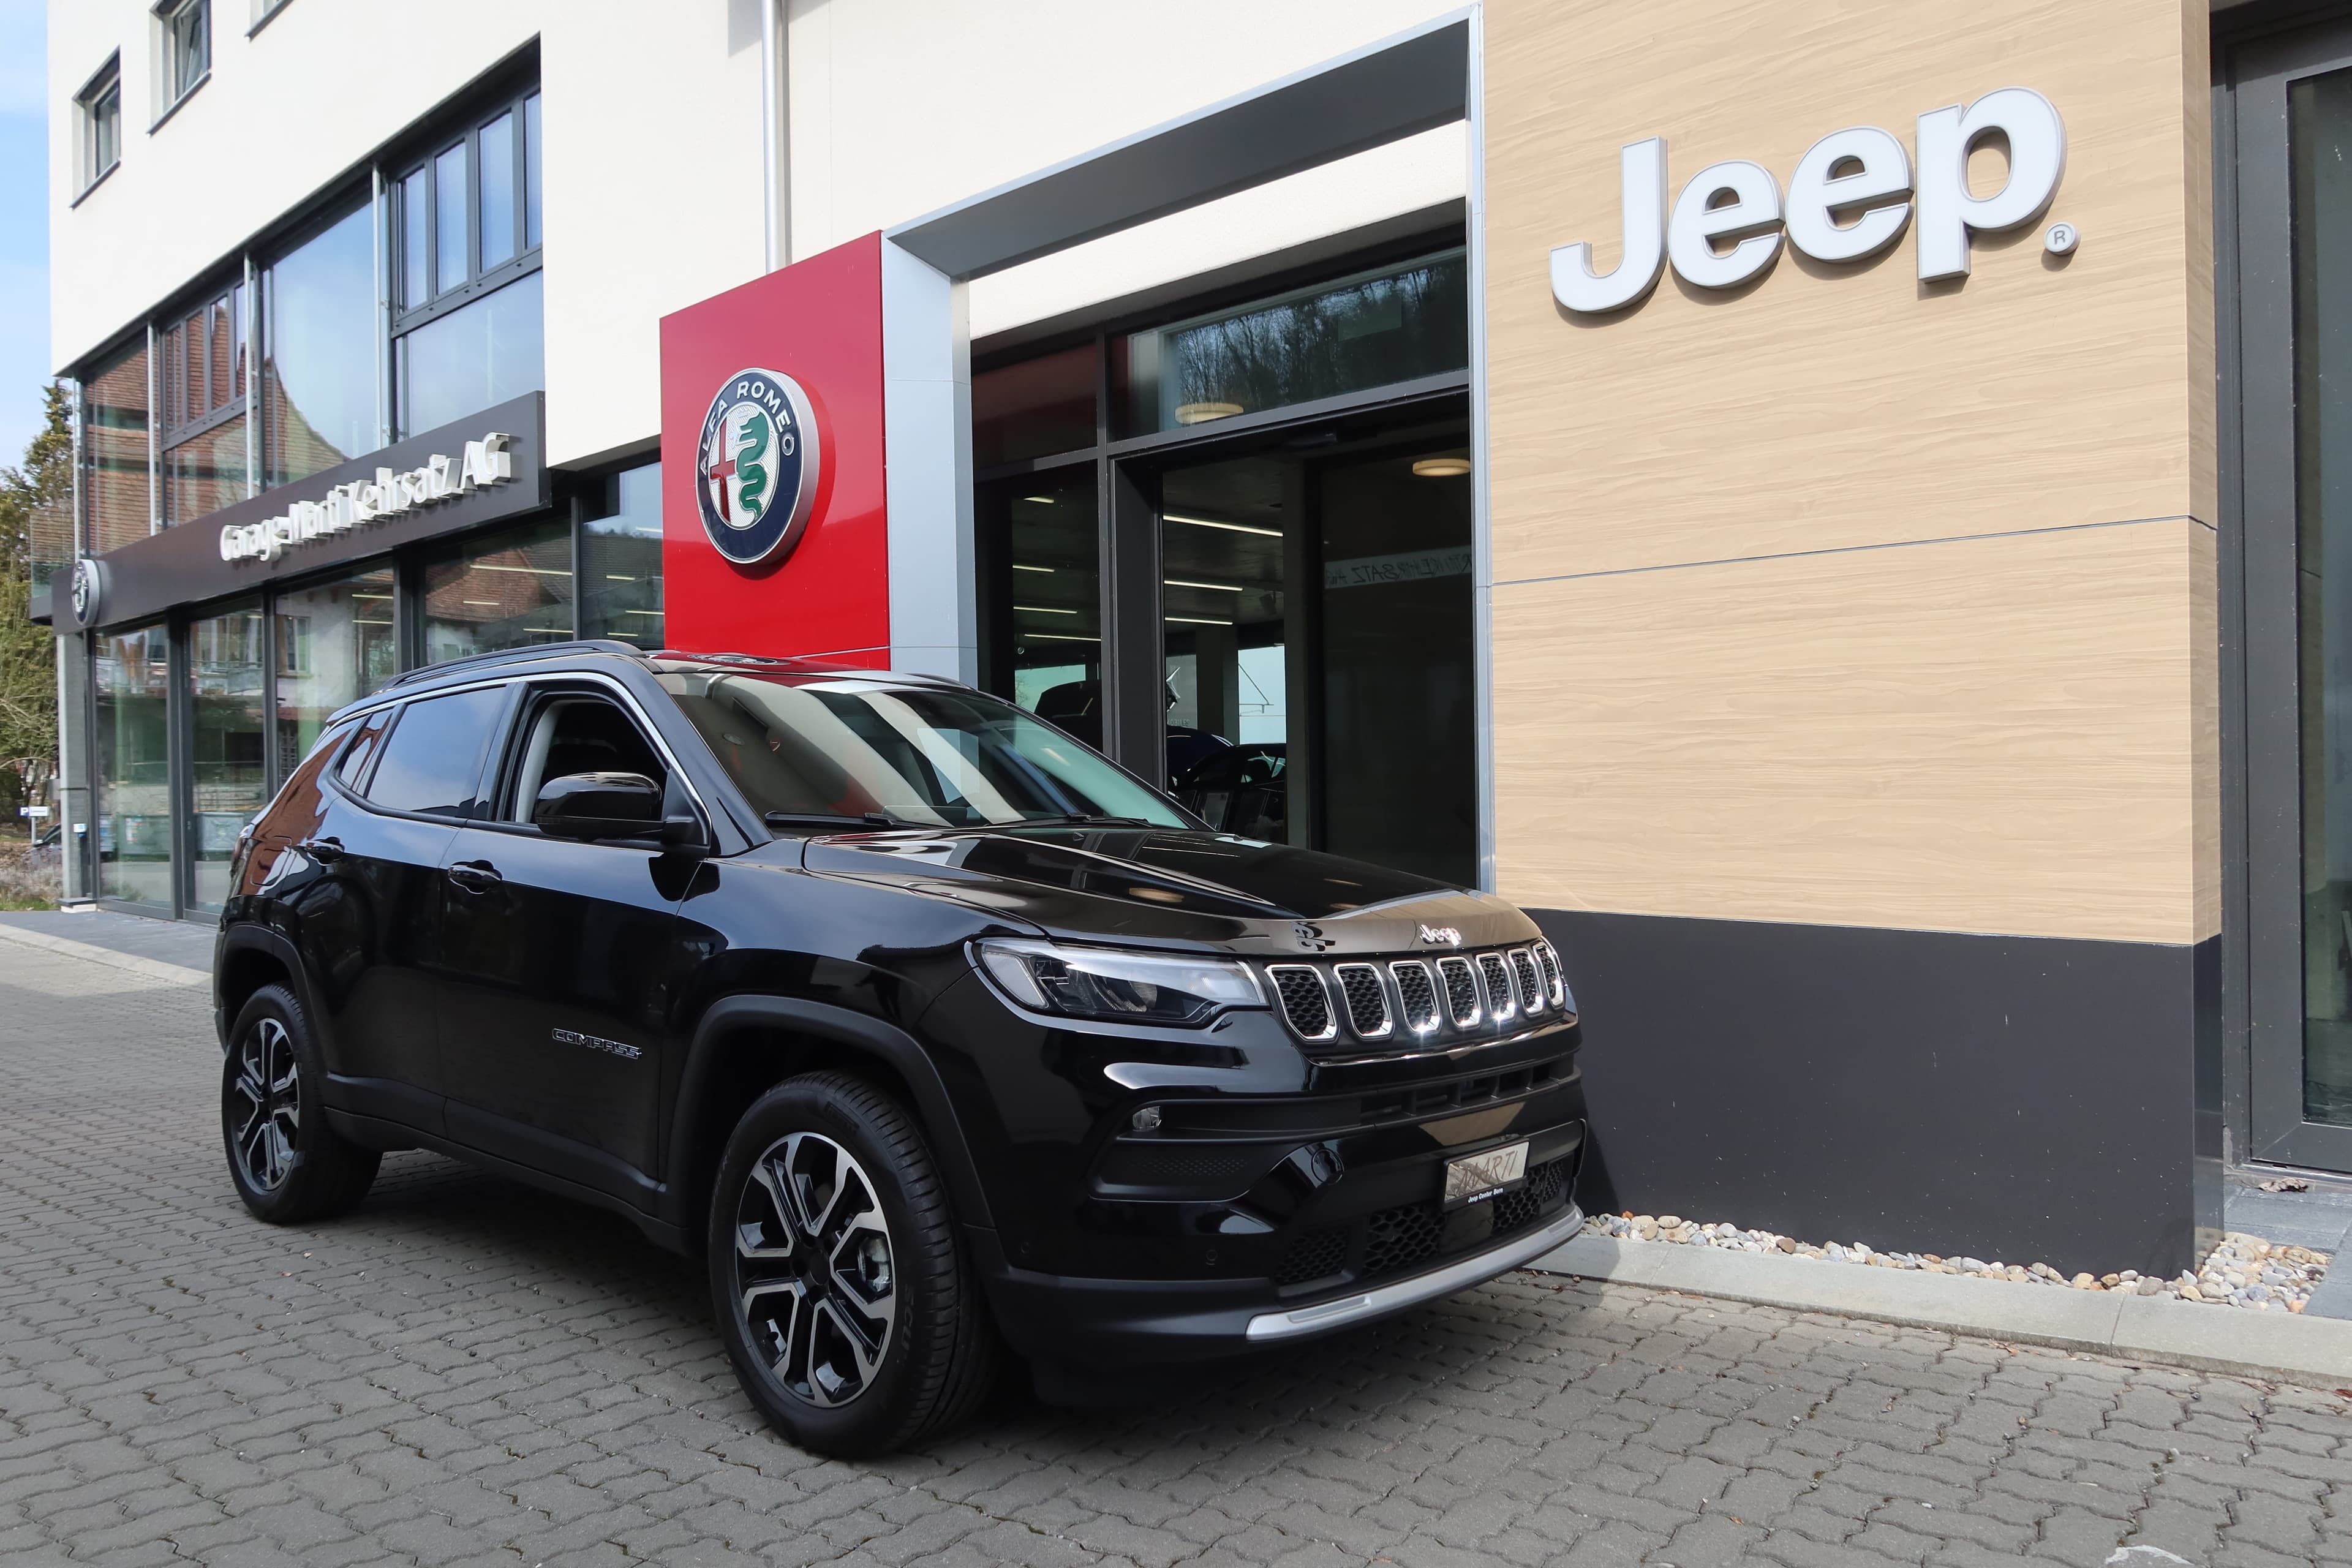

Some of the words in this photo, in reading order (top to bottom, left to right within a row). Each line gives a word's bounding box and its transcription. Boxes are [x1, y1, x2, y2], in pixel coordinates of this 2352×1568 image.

[1548, 85, 2067, 314] Jeep
[699, 399, 729, 476] ALFA
[736, 380, 795, 456] ROMEO
[220, 516, 292, 562] Garage
[288, 485, 352, 544] Marti
[347, 454, 464, 525] Kehrsatz
[460, 432, 511, 491] AG
[20, 807, 29, 816] P
[1419, 924, 1462, 947] Jeep
[552, 1028, 642, 1060] COMPASS
[1479, 1190, 1493, 1200] Center
